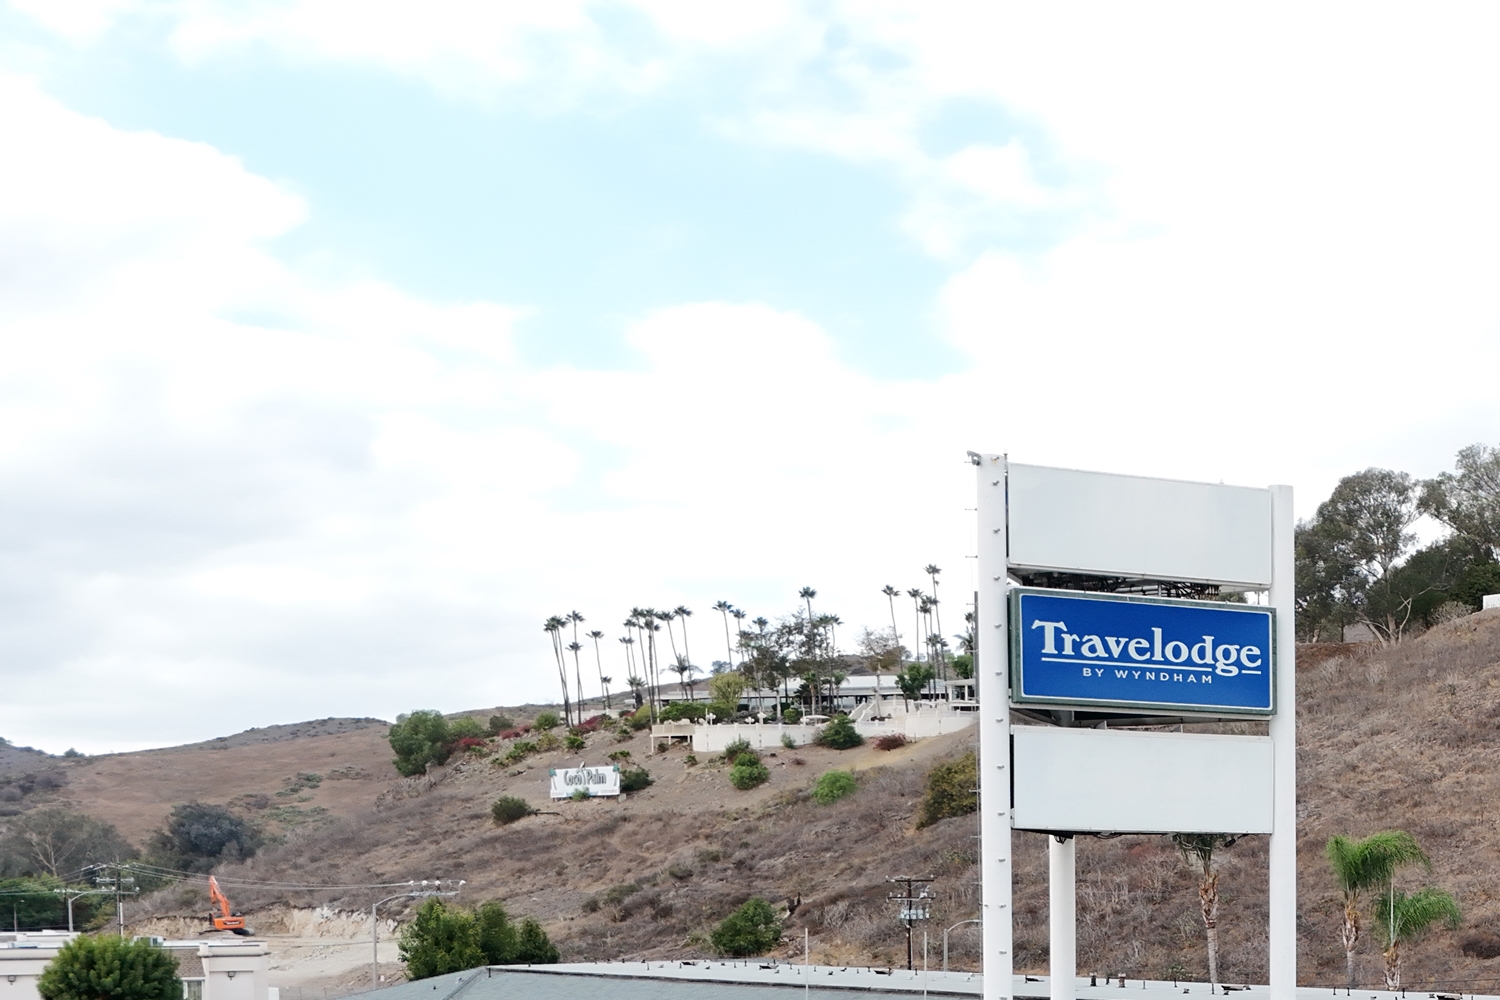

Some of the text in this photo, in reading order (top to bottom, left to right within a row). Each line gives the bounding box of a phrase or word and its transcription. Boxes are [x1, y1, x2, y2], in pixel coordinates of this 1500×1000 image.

[1031, 619, 1262, 677] Travelodge
[1083, 667, 1213, 684] BY WYNDHAM
[586, 768, 607, 785] Palm
